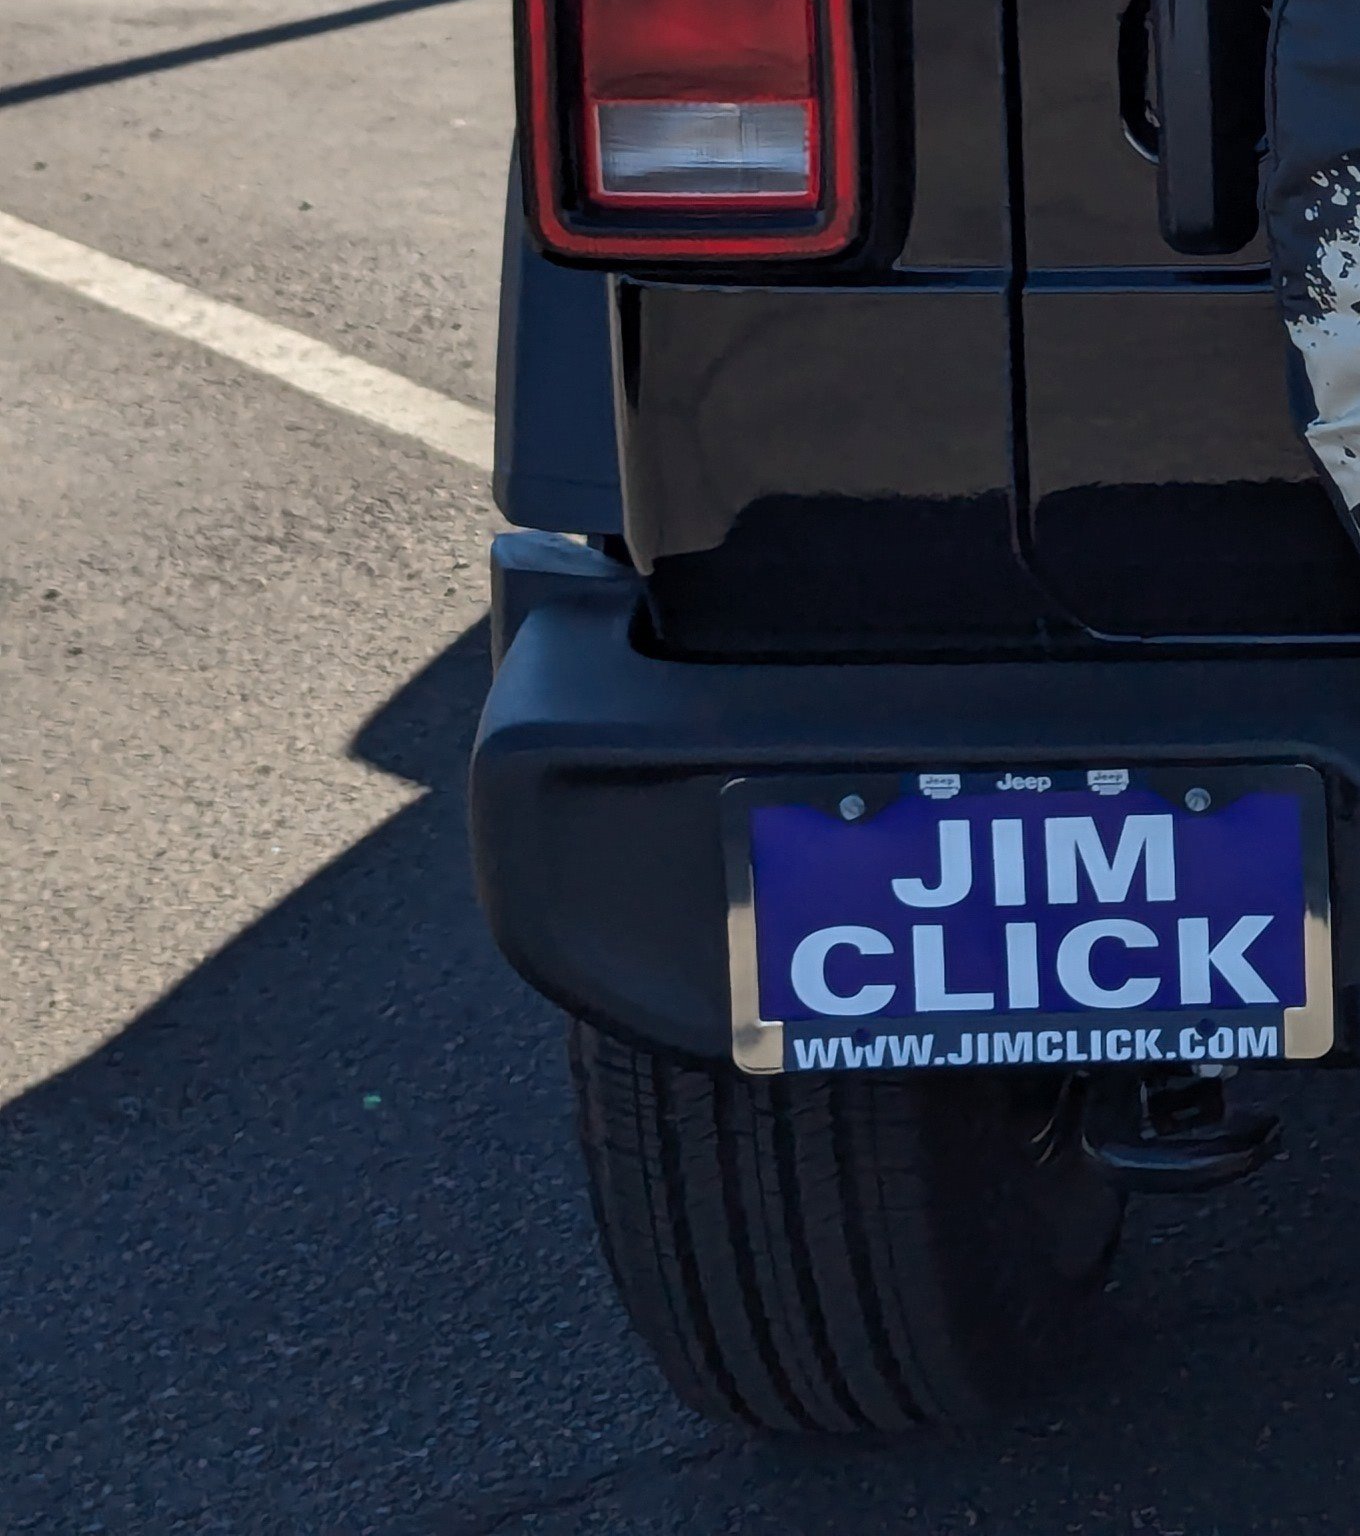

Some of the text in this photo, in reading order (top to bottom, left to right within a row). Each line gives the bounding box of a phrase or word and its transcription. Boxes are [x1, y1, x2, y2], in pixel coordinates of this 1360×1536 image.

[996, 772, 1052, 793] Jeep
[891, 813, 1176, 908] JIM
[790, 914, 1280, 1016] CLICK
[793, 1026, 1279, 1069] WWW.JIMCLICK.COM
